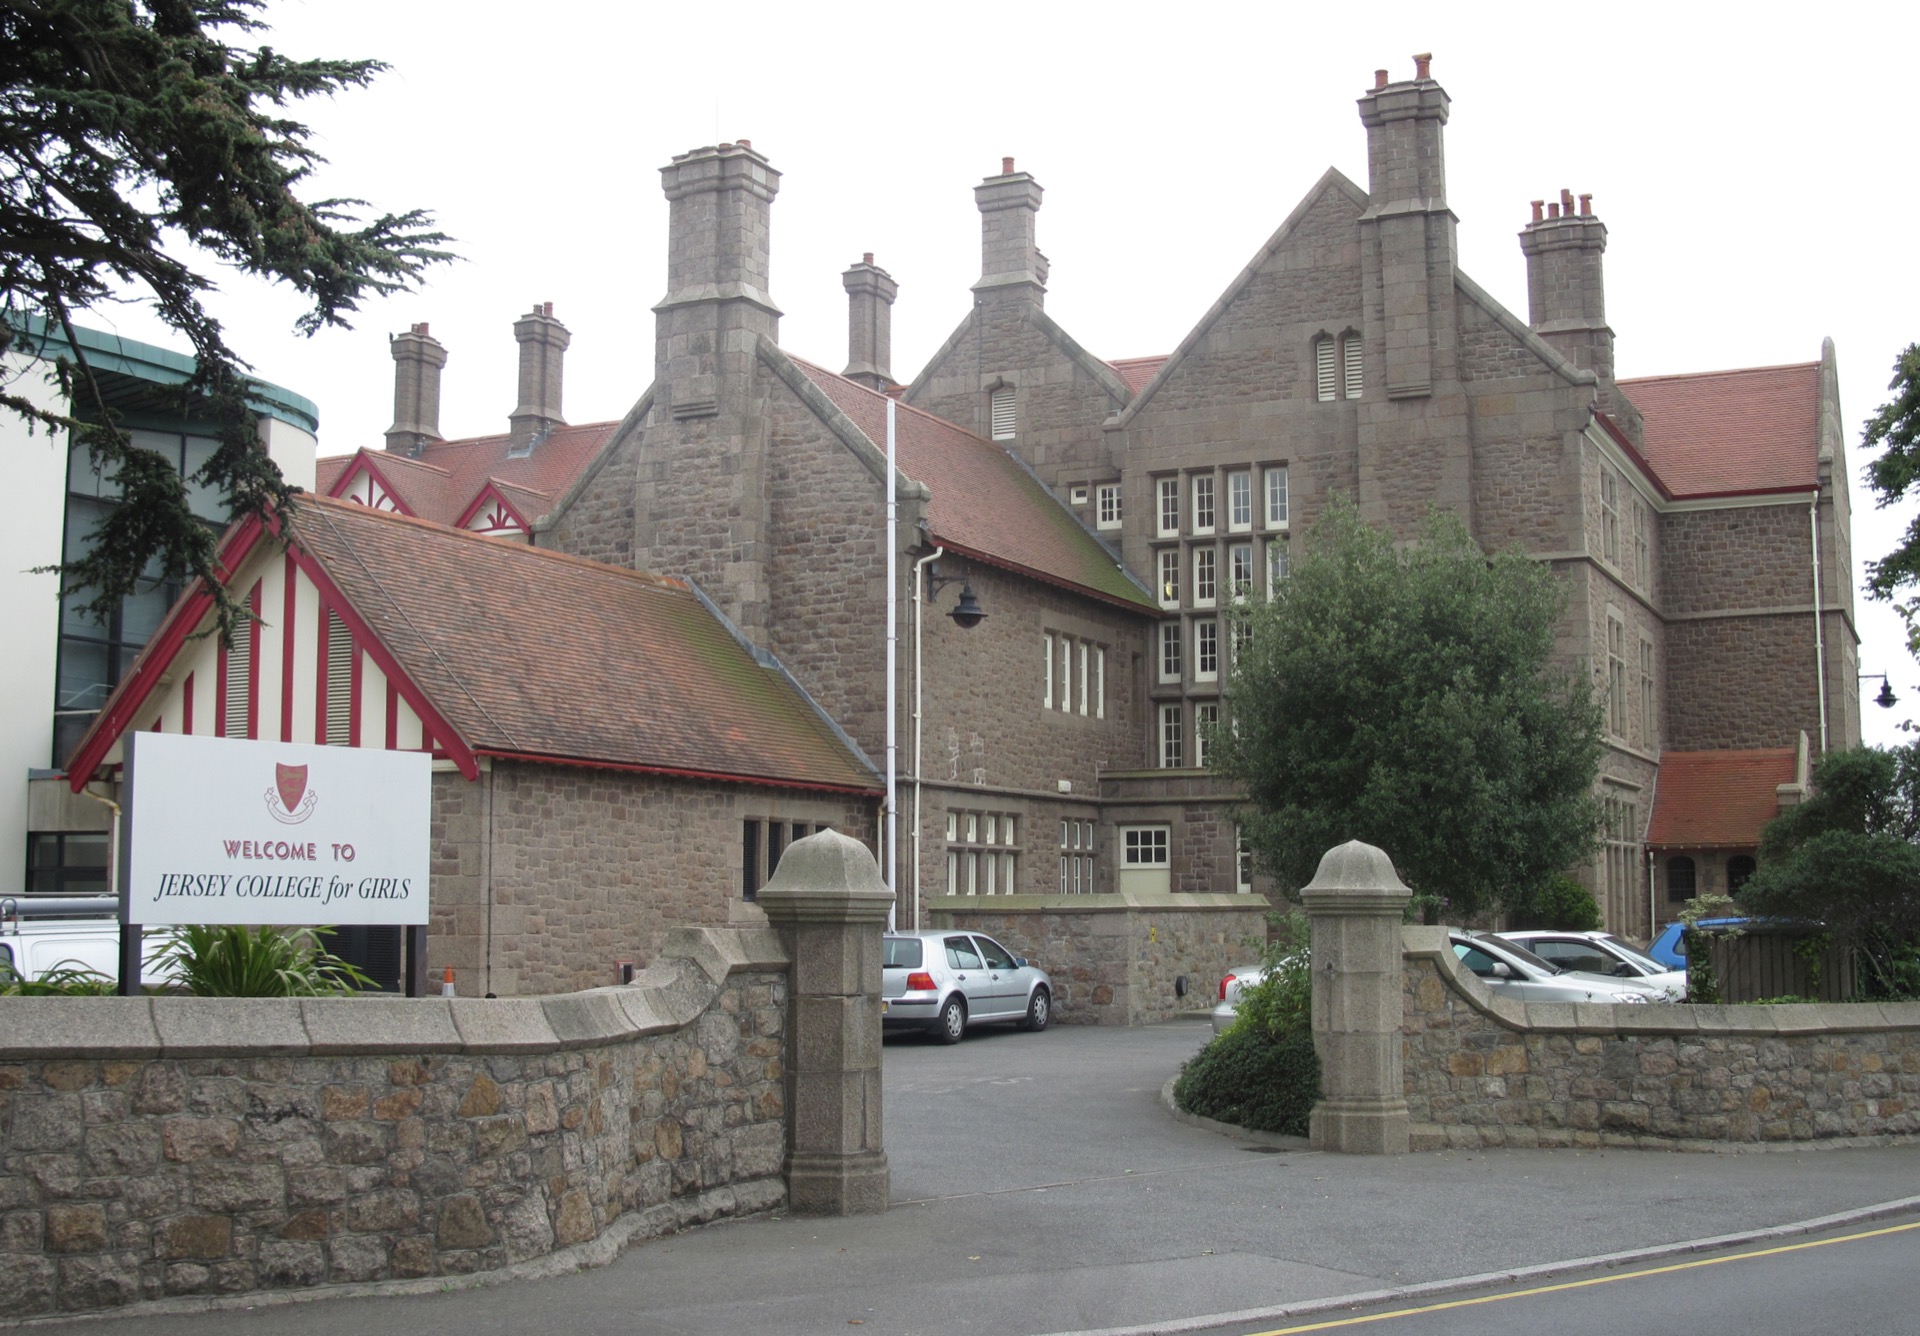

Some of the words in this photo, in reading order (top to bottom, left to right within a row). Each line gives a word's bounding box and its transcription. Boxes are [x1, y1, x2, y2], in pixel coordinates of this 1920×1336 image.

[223, 840, 317, 861] WELCOME
[331, 843, 356, 862] TO
[153, 873, 233, 902] JERSEY
[235, 874, 323, 898] COLLEGE
[321, 874, 354, 905] for
[358, 877, 412, 900] GIRLS
